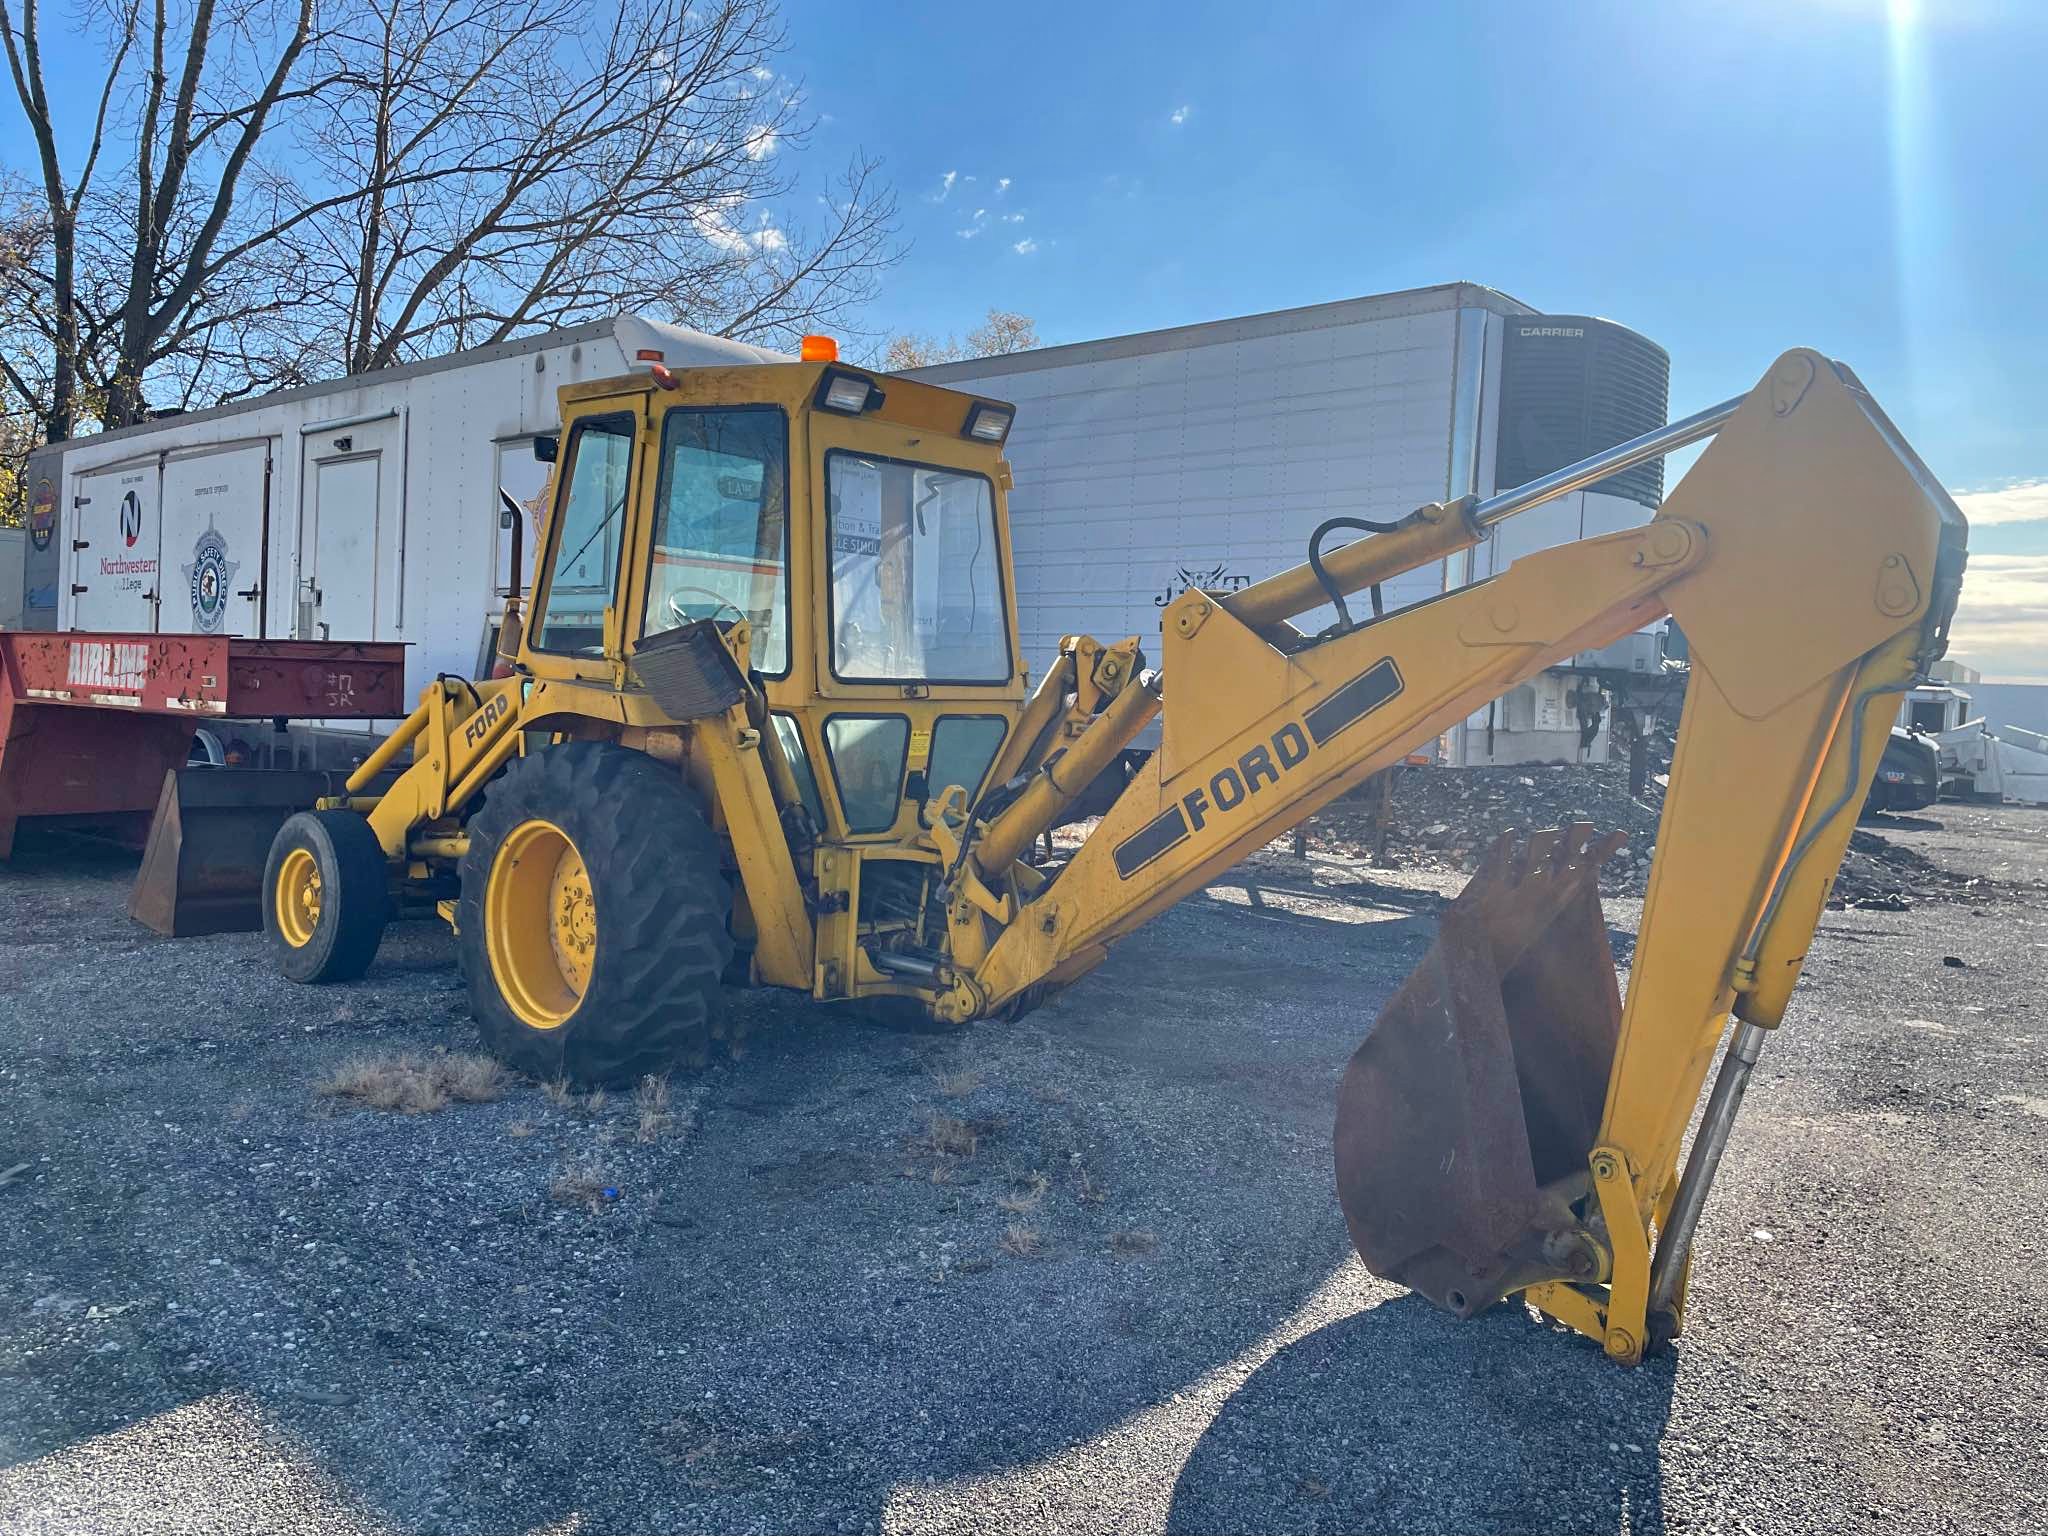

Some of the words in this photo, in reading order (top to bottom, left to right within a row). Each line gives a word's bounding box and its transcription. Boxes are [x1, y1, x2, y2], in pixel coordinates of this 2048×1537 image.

[1520, 327, 1584, 337] CARRIER
[192, 561, 201, 605] PUBLIC
[201, 547, 220, 561] SAFETY
[68, 642, 149, 689] AIRLINE
[465, 694, 508, 748] FORD
[1183, 722, 1310, 832] FORD
